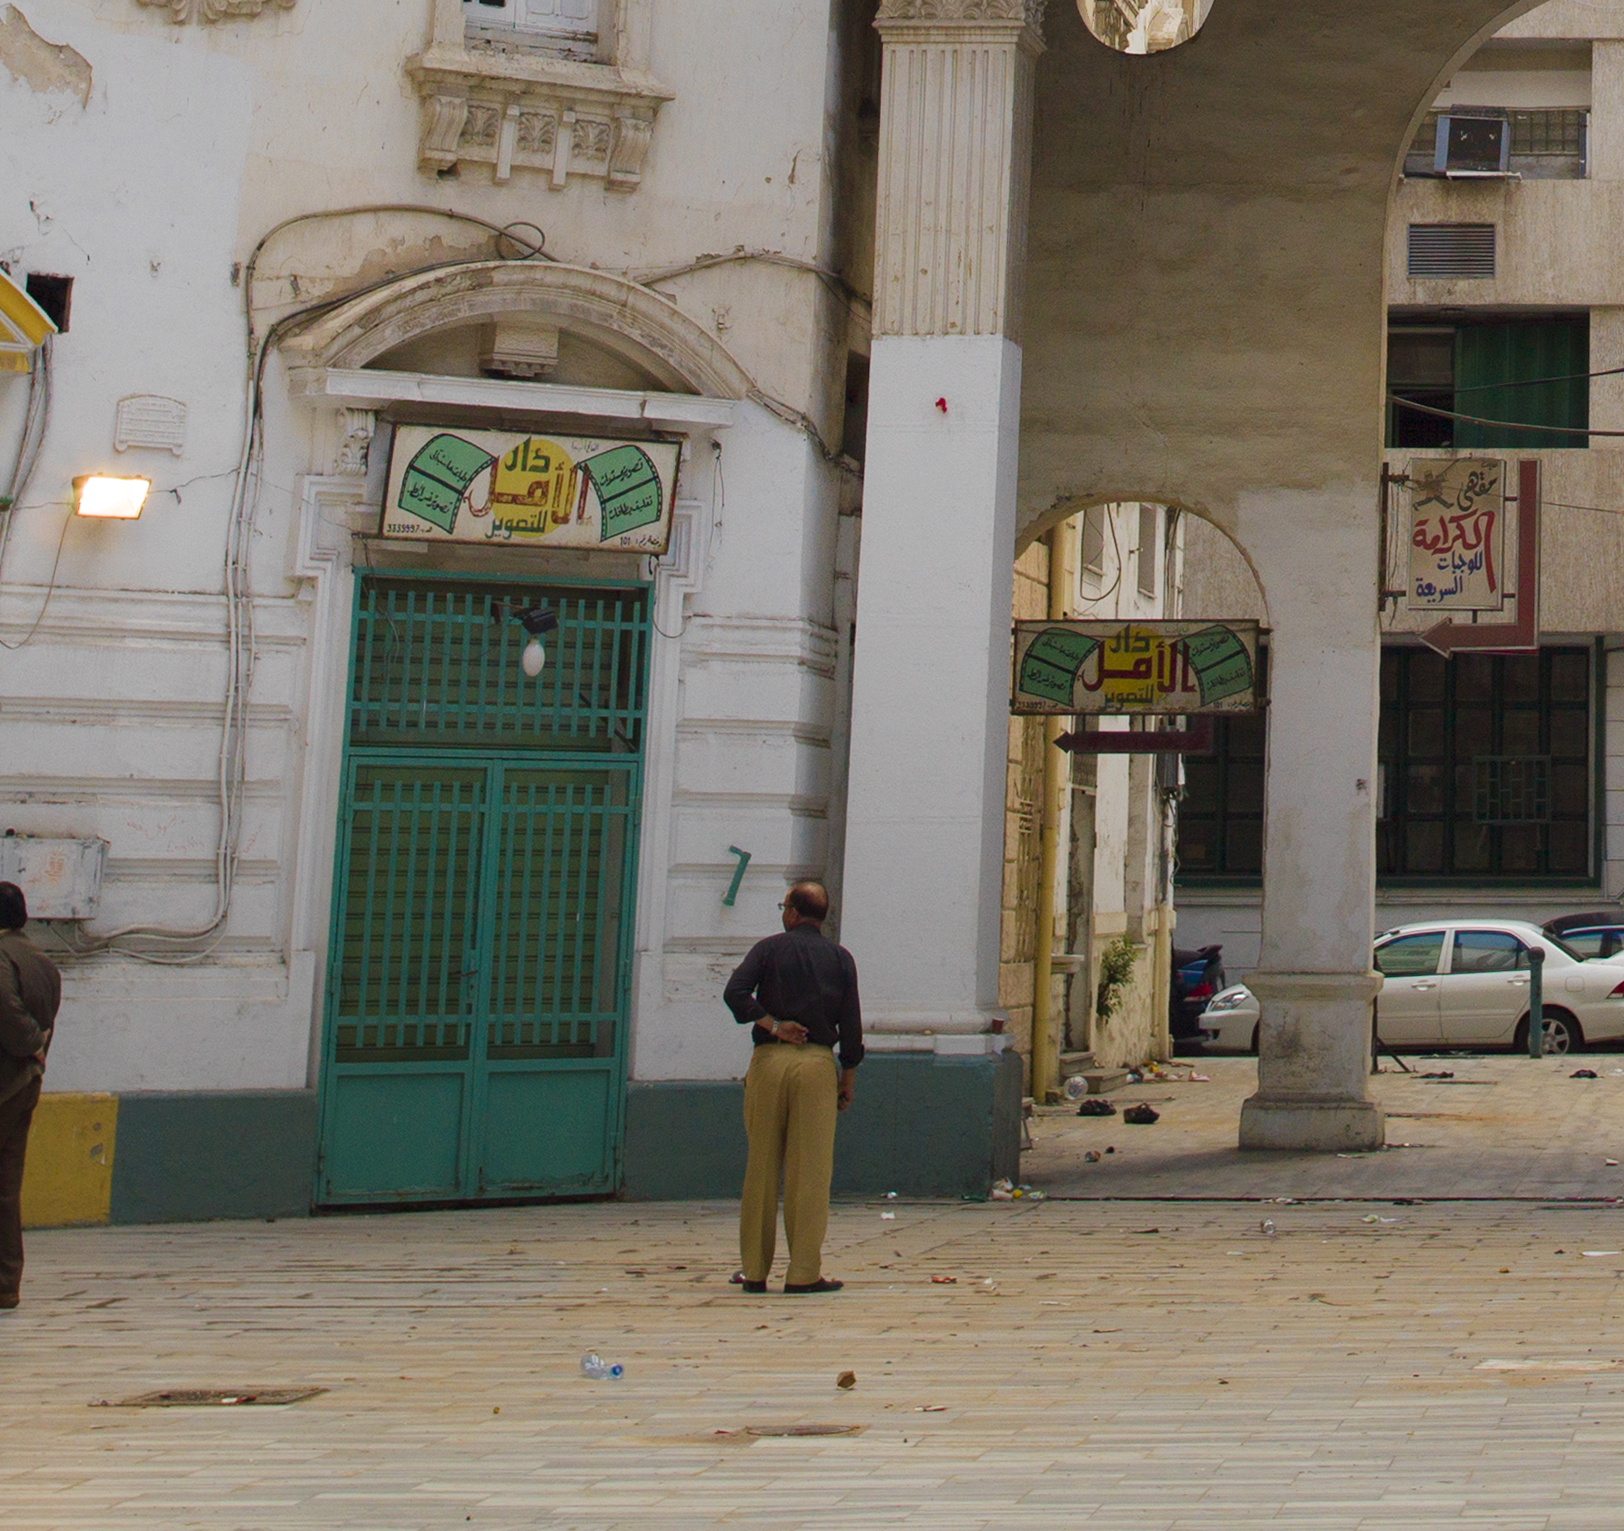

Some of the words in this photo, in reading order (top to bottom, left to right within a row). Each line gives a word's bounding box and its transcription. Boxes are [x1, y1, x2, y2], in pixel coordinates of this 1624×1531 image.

[504, 436, 550, 473] دار
[463, 456, 593, 525] الأمل
[485, 510, 547, 540] للتصوير
[1412, 508, 1497, 594] الكرامة
[1437, 550, 1483, 576] للوجبات
[1415, 575, 1463, 603] السريعة
[1109, 623, 1151, 654] دار
[1078, 640, 1198, 693] الأمل
[1104, 683, 1154, 711] للتصوير
